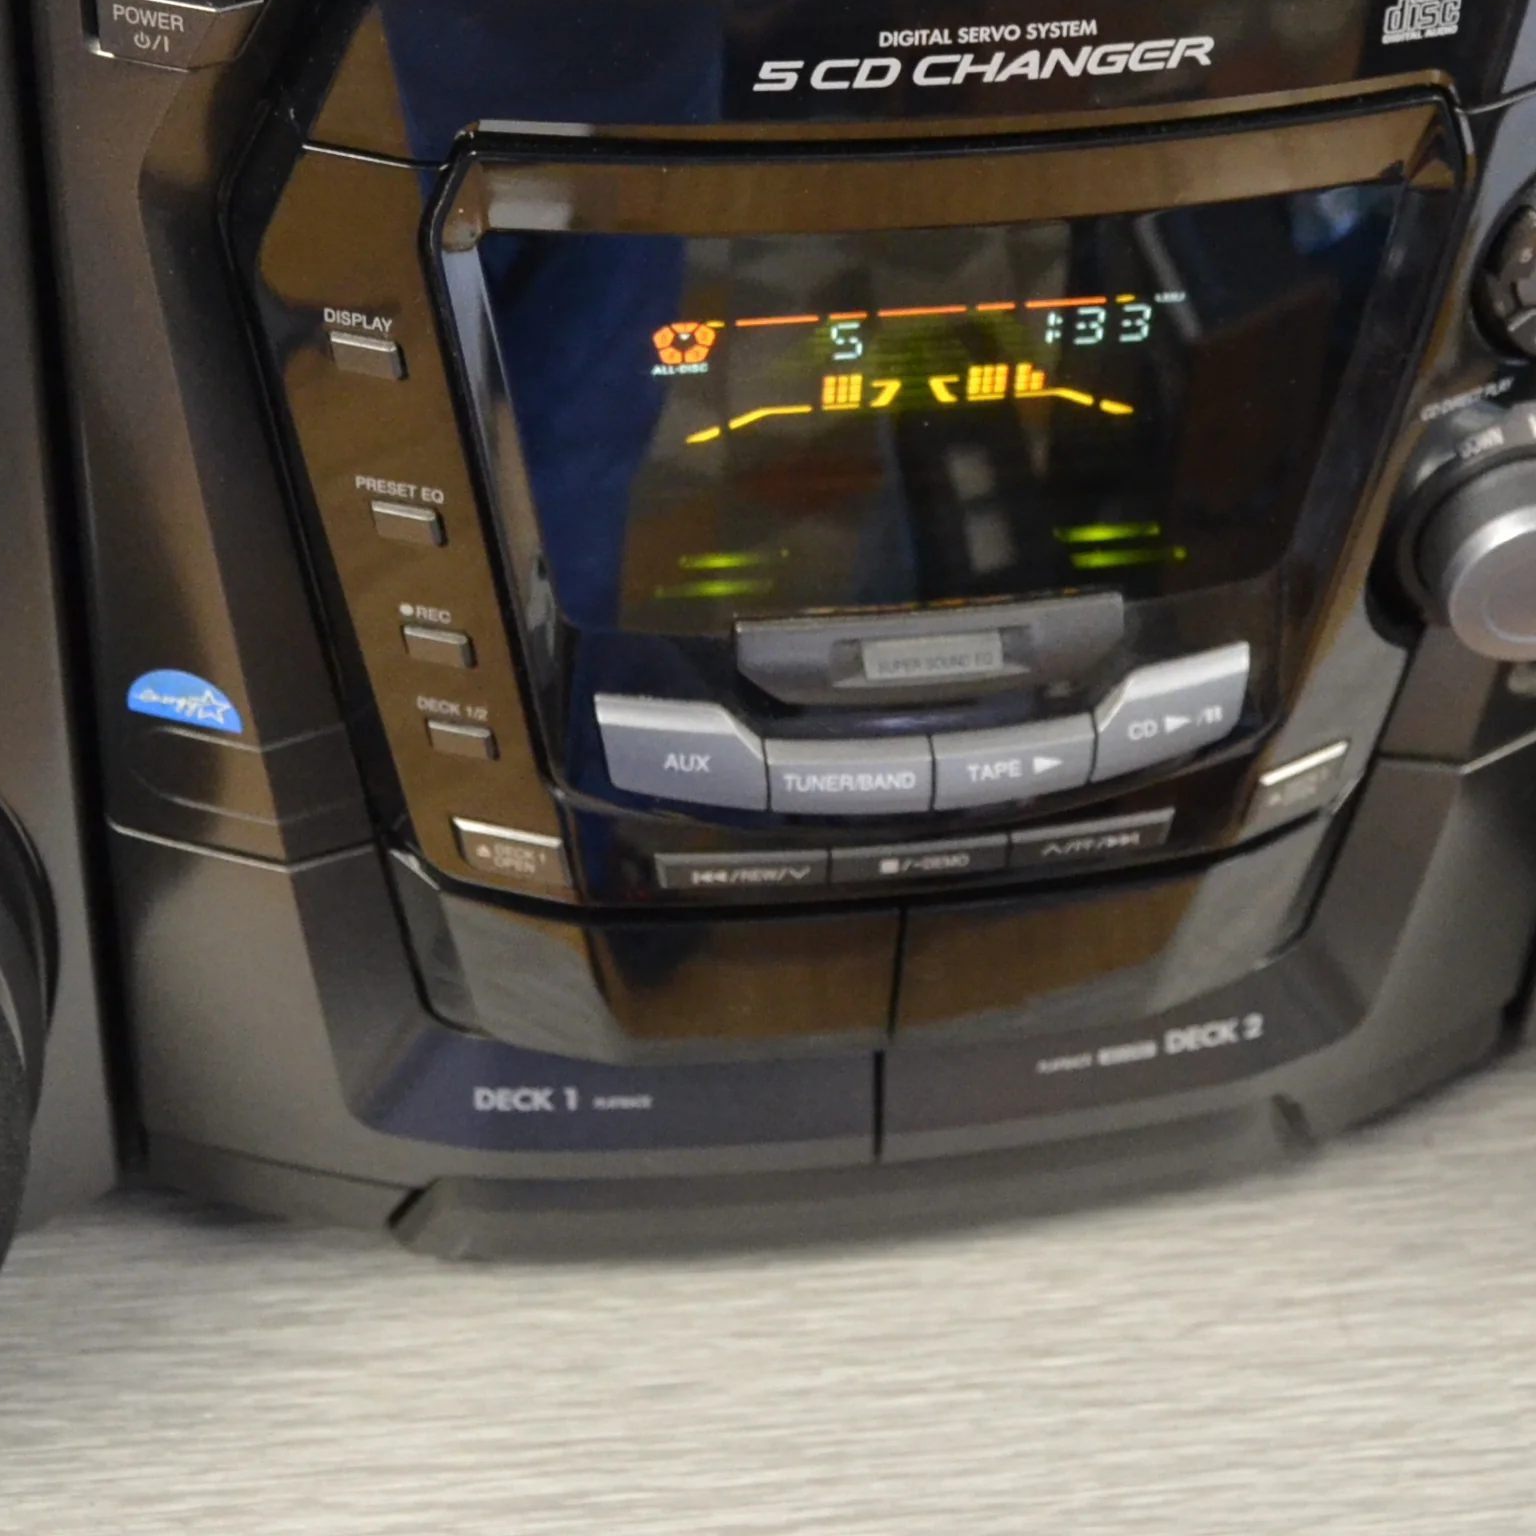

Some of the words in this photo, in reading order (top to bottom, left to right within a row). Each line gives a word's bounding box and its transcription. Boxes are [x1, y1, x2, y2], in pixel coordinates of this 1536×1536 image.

[112, 3, 184, 33] POWER
[879, 27, 951, 48] DIGITAL
[957, 24, 1021, 44] SERVO
[1025, 19, 1097, 41] SYSTEM
[809, 55, 902, 90] CD
[911, 36, 1215, 87] CHANGER
[323, 307, 393, 333] DISPLAY
[355, 476, 417, 499] PRESET
[421, 487, 445, 504] EQ
[416, 604, 452, 624] REC
[416, 695, 460, 716] DECK
[1127, 720, 1159, 740] CD
[664, 753, 712, 773] AUX
[966, 759, 1023, 783] TAPE
[783, 771, 916, 793] TUNER/BAND
[1164, 1016, 1240, 1055] DECK
[1242, 1011, 1263, 1041] 2
[473, 1085, 555, 1112] DECK
[563, 1085, 579, 1112] 1
